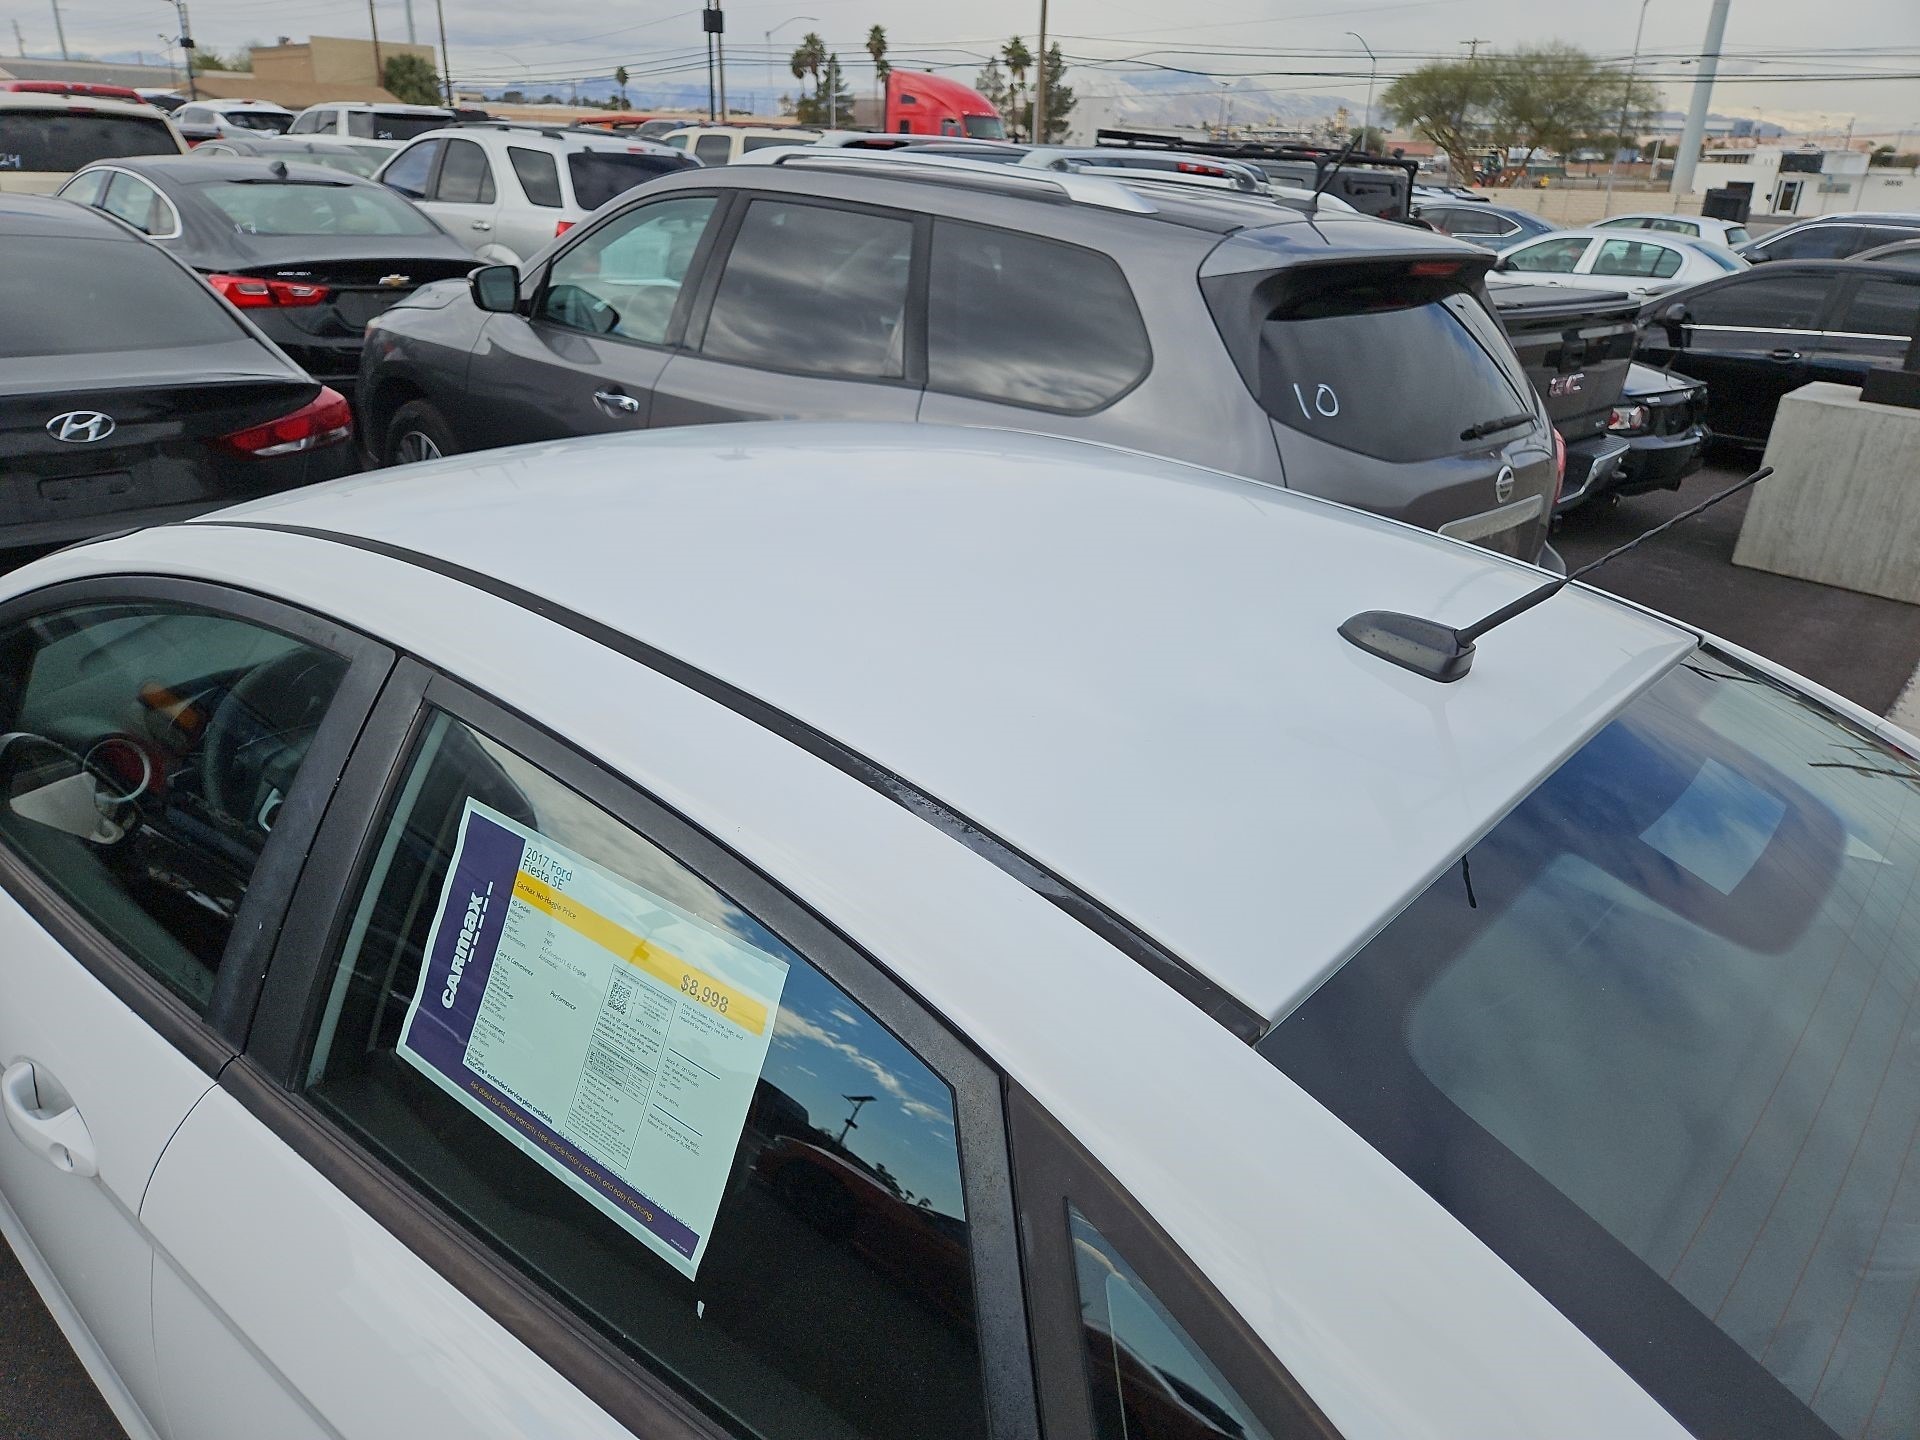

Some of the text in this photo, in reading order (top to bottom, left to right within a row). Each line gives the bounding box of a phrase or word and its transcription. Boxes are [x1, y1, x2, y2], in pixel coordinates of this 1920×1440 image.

[1293, 383, 1340, 420] 10
[522, 858, 564, 891] Fiesta SE
[525, 847, 572, 881] 2017 Ford
[516, 880, 535, 895] CarMax
[562, 906, 576, 919] Price
[549, 990, 576, 1010] Performance
[680, 974, 728, 1013] $8,998
[486, 1073, 508, 1090] extended
[506, 1087, 522, 1102] service
[521, 1099, 532, 1109] plan
[532, 1106, 552, 1124] available
[470, 1080, 478, 1090] Ask
[478, 1087, 492, 1101] about
[491, 1097, 501, 1106] our
[499, 1102, 516, 1118] limited
[537, 1130, 548, 1143] free
[548, 1139, 567, 1157] vehicle
[566, 1151, 582, 1169] history
[602, 1180, 614, 1191] and
[613, 1188, 626, 1201] easy
